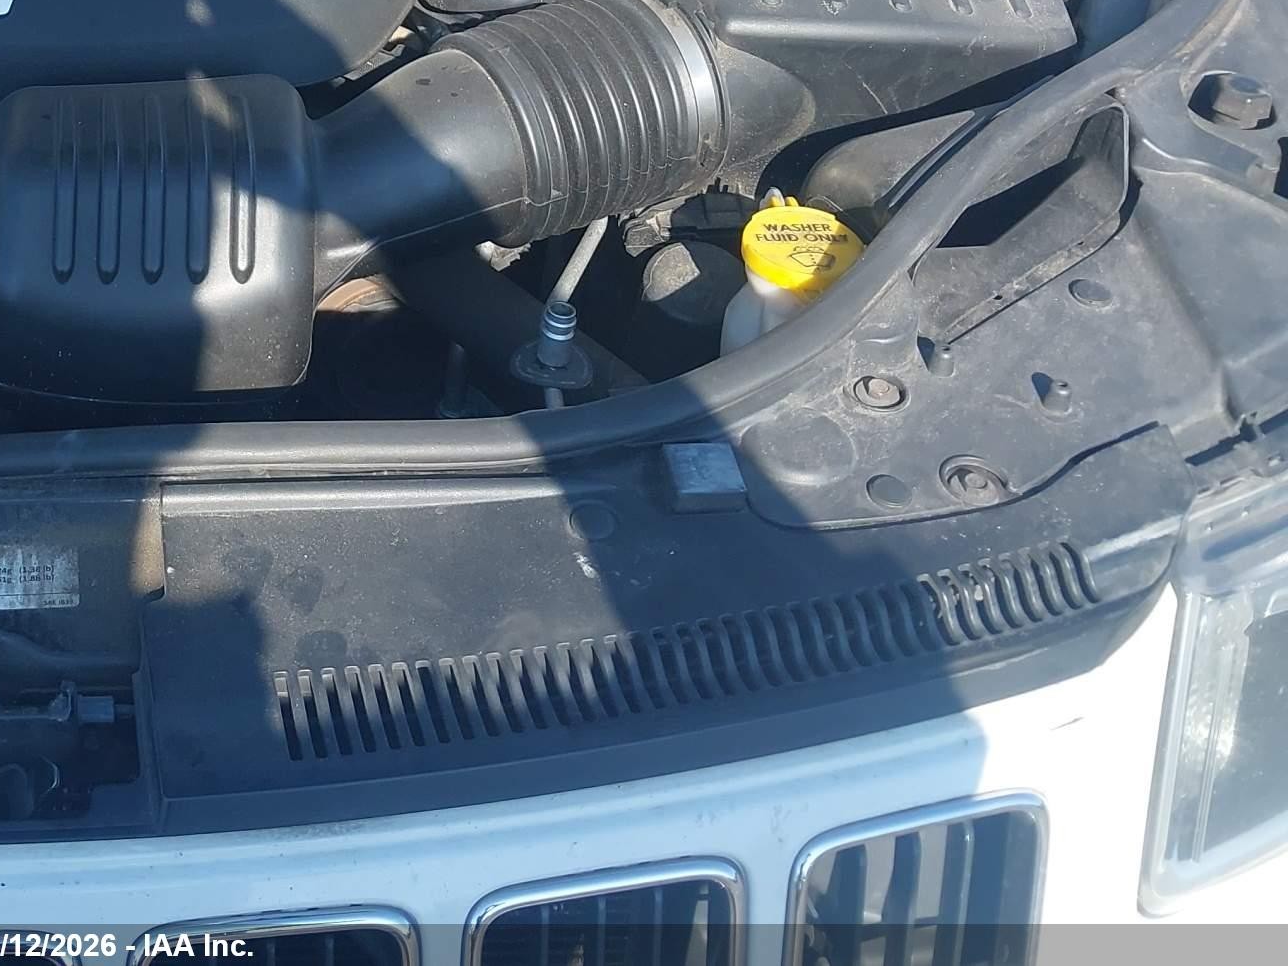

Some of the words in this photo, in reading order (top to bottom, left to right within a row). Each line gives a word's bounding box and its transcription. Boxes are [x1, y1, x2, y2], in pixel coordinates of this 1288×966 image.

[763, 223, 832, 231] WASHER
[804, 234, 848, 242] ONLY
[42, 565, 55, 574] lb)
[42, 573, 55, 582] lb)
